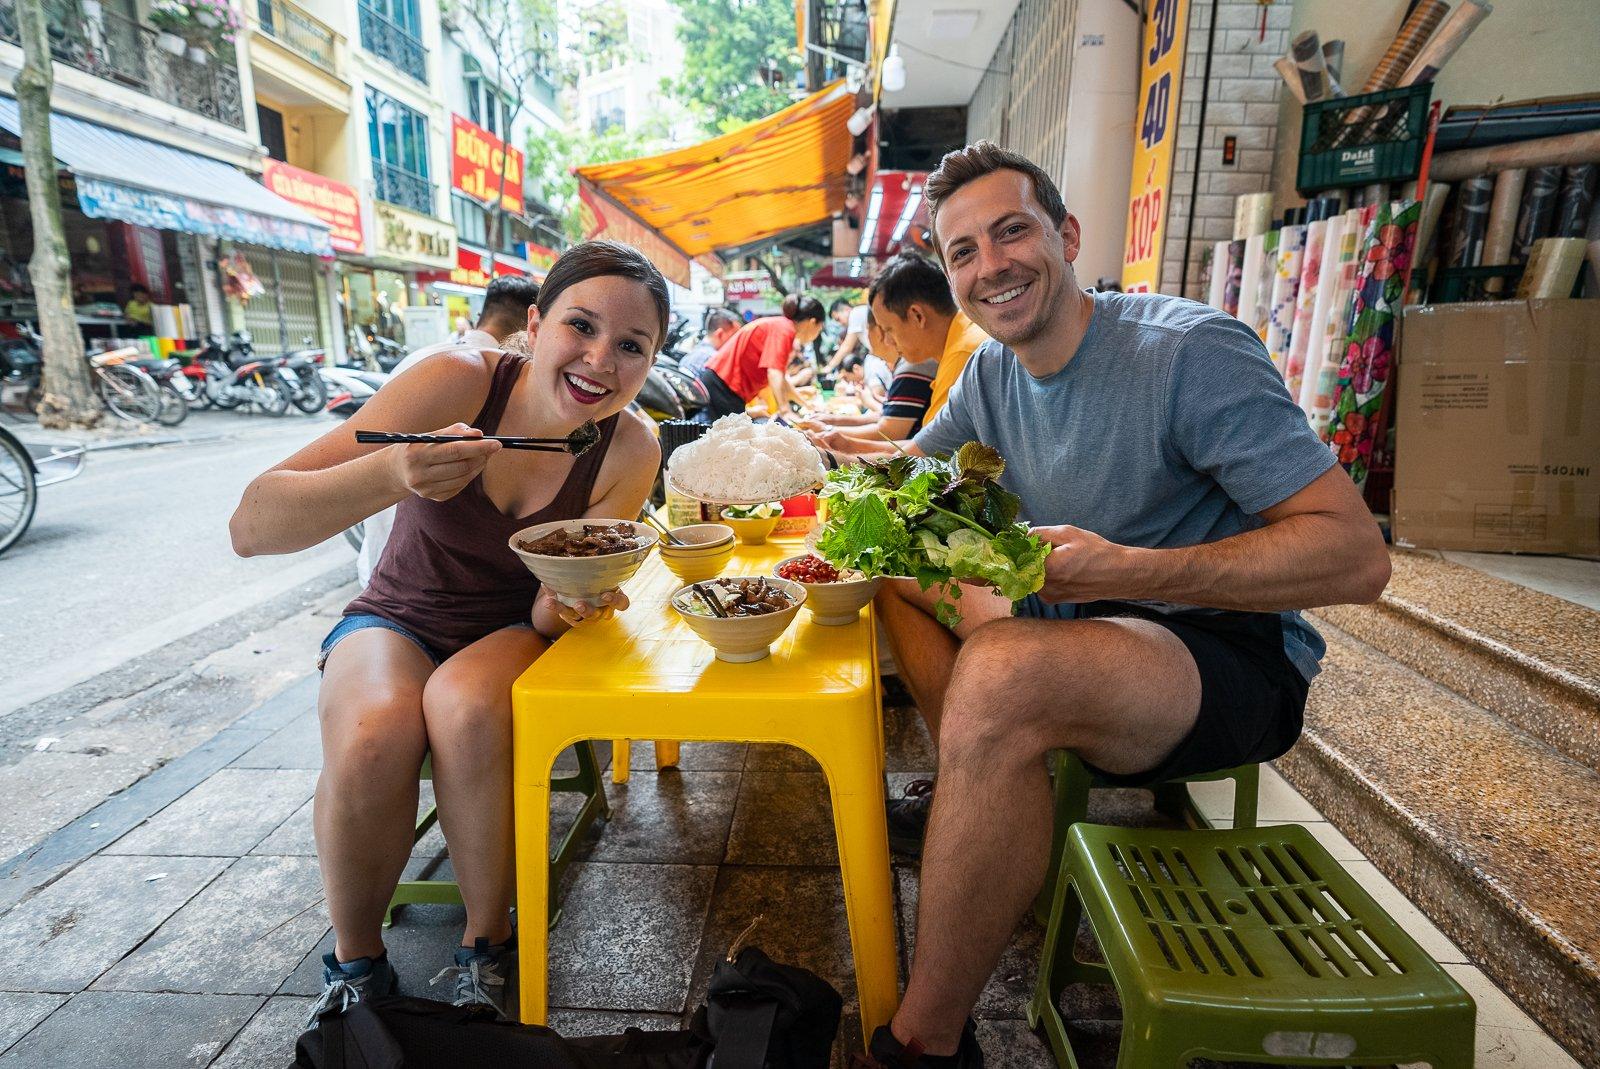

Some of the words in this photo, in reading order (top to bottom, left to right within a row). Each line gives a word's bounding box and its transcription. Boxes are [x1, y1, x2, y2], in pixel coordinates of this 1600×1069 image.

[1148, 0, 1179, 66] 3D
[1141, 71, 1172, 149] 4D
[456, 127, 489, 168] BÚN
[1543, 465, 1590, 477] INTOPS
